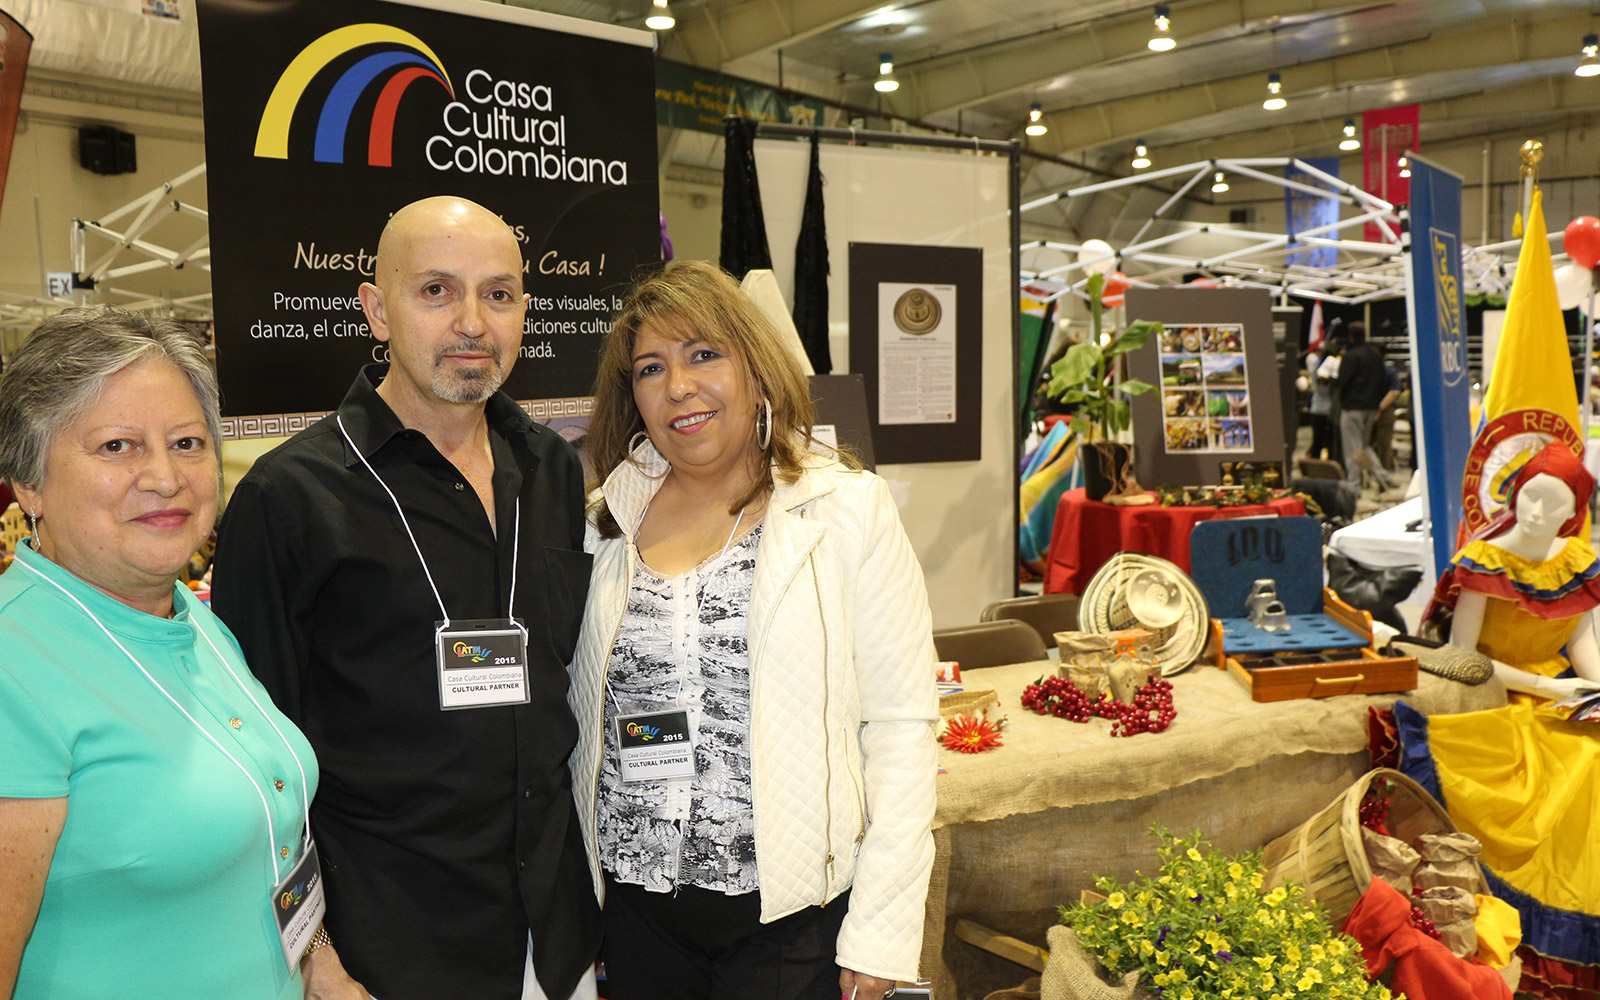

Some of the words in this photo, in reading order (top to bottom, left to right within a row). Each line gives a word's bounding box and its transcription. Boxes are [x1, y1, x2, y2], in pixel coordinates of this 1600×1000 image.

[465, 69, 553, 112] Casa
[443, 101, 565, 147] Cultural
[425, 135, 628, 185] Colombiana
[293, 241, 377, 276] Nuestr
[539, 250, 590, 276] Casa
[529, 296, 554, 311] rtes
[556, 294, 610, 313] visuales,
[612, 295, 623, 310] la
[250, 319, 309, 340] danza,
[313, 318, 328, 338] el
[333, 320, 373, 339] cine,
[523, 317, 577, 334] diciones
[519, 341, 556, 359] nadá.
[1441, 341, 1461, 372] RBC
[1522, 411, 1584, 458] REPUB
[1466, 459, 1483, 488] DE
[1227, 526, 1287, 566] 100
[494, 656, 516, 665] 2015
[447, 675, 463, 683] Casa
[464, 673, 488, 682] Cultural
[488, 671, 522, 680] Colombiana
[489, 682, 520, 691] PARTNER
[662, 733, 684, 742] 2015
[628, 760, 658, 768] CULTURAL
[659, 757, 689, 765] PARTNER
[639, 750, 658, 758] Cultural
[657, 748, 687, 756] Colombiana
[307, 872, 317, 892] 2015
